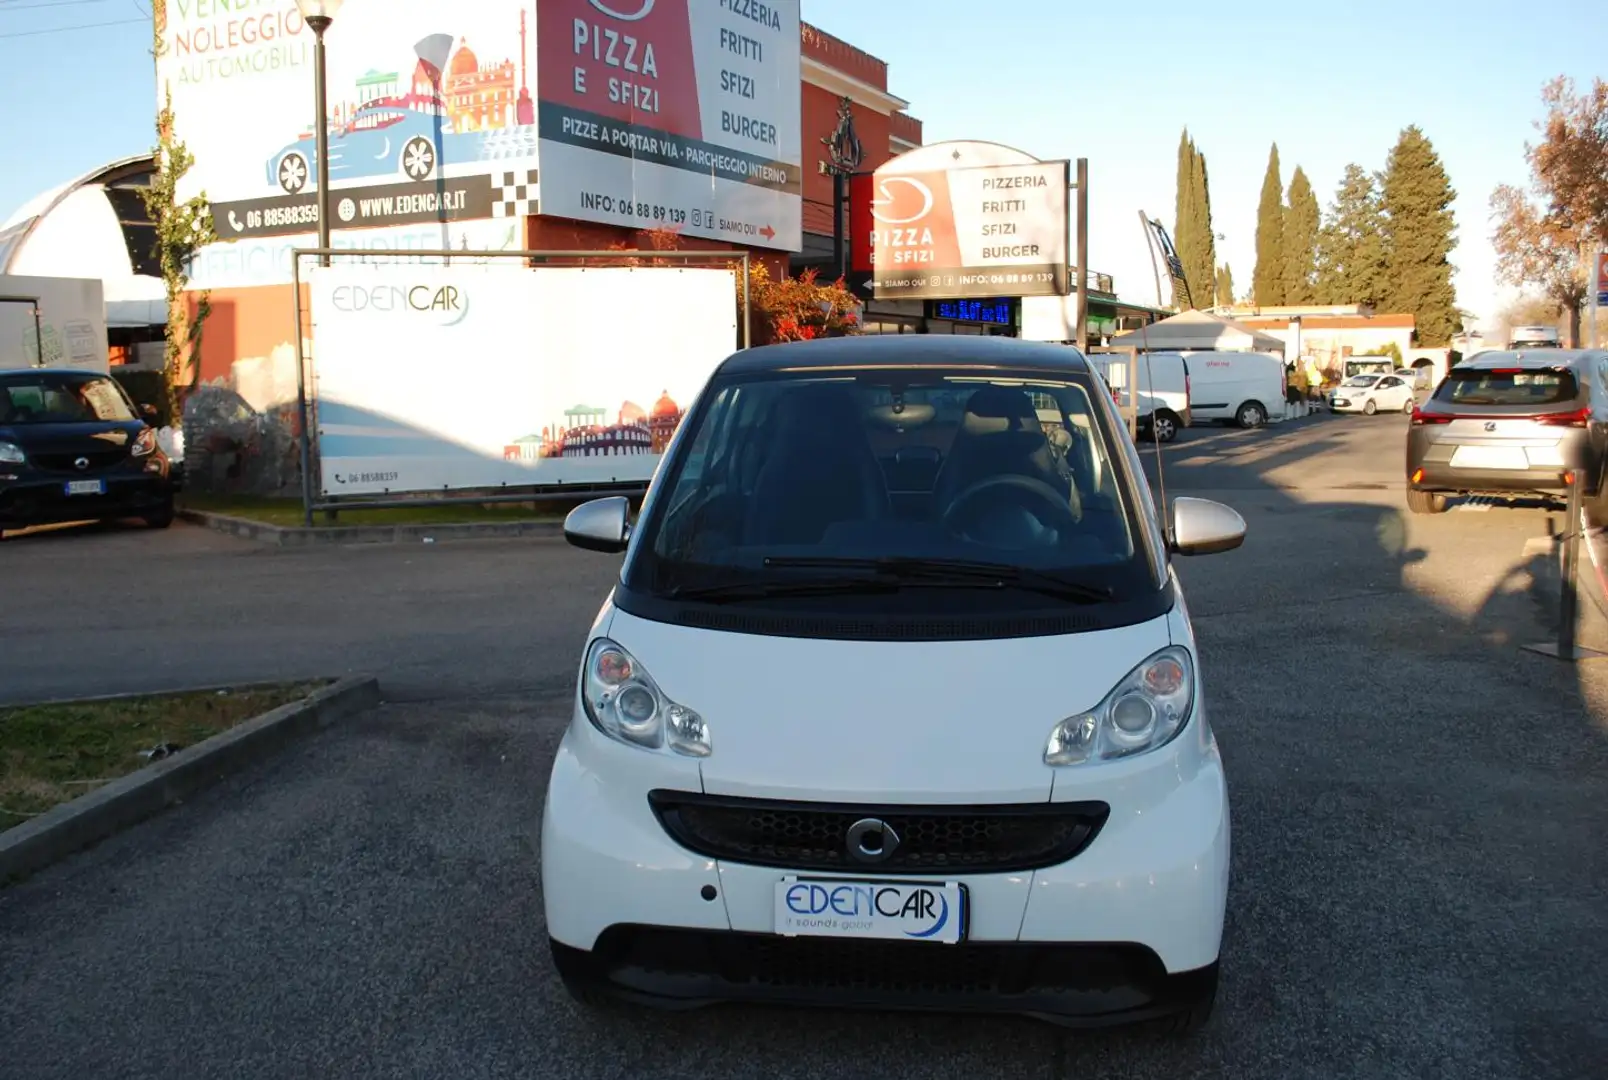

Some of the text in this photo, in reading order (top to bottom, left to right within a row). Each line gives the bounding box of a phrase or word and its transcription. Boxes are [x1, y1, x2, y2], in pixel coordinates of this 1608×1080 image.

[175, 8, 304, 56] NOLEGGIO
[720, 27, 762, 62] FRITTI
[572, 17, 658, 78] PIZZA
[178, 42, 306, 85] AUTOMOBILI
[573, 66, 660, 113] E SFIZI
[720, 70, 755, 99] SFIZI
[721, 111, 777, 145] BURGER
[562, 116, 787, 184] PIZZE A PORTAR VIA PARCHEGGIO INTERNO
[982, 174, 1048, 190] PIZZERIA
[246, 203, 319, 229] 06 88588359
[360, 190, 466, 218] WWW.EDENCAR.IT
[580, 191, 686, 223] INFO: 06 88 89 139
[982, 199, 1025, 213] FRITTI
[719, 218, 757, 236] SIAMO QUI
[869, 227, 934, 248] PIZZA
[981, 224, 1016, 236] SFIZI
[894, 250, 934, 263] SFIZI
[982, 244, 1039, 259] BURGER
[885, 272, 1053, 288] SIAMO QUI INFO: 06 88 89 139
[332, 285, 459, 311] EDENCAR
[348, 471, 359, 483] 06
[785, 884, 936, 919] EDENCAR
[796, 918, 837, 928] sounds
